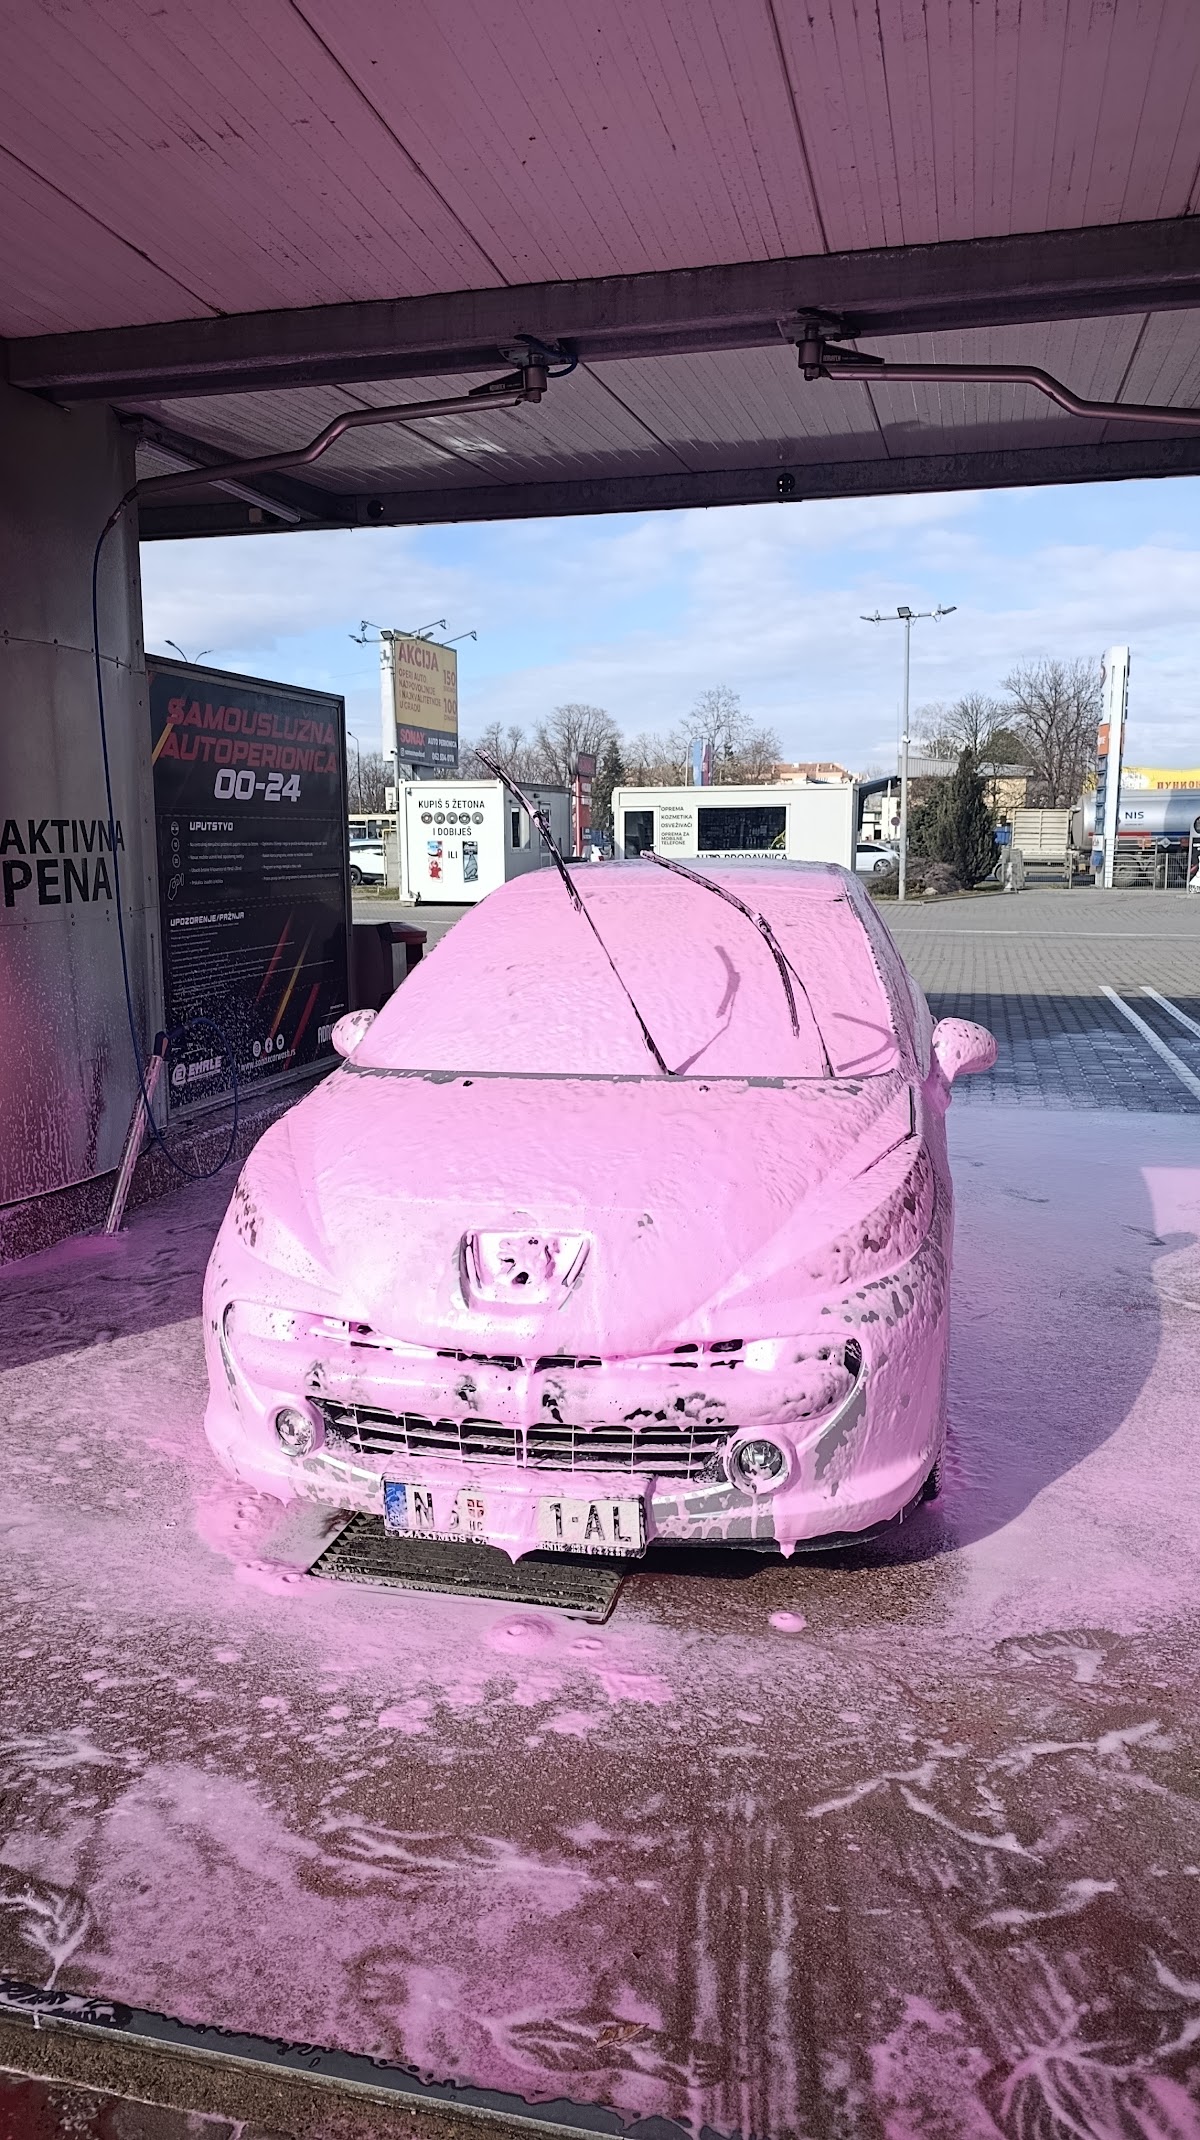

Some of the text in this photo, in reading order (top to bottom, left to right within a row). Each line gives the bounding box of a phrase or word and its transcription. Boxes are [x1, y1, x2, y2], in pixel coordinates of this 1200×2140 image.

[399, 642, 439, 672] AKCIJA
[414, 672, 427, 683] AUTO
[443, 670, 456, 687] 150
[444, 698, 457, 715] 100
[400, 728, 425, 746] SONAX
[160, 732, 338, 774] AUTOPERIONICA
[214, 769, 302, 803] 00-24
[418, 798, 485, 809] KUPIŠ 5 ŽETONA
[1125, 811, 1144, 820] NIS
[189, 821, 234, 832] UPUTSTVO
[432, 826, 472, 836] I DOBIJEŠ
[0, 819, 125, 855] AKTIVNA
[448, 851, 458, 859] ILI
[2, 857, 113, 908] PENA
[549, 1502, 632, 1542] 1-AL
[398, 1530, 467, 1543] MAXIMUS
